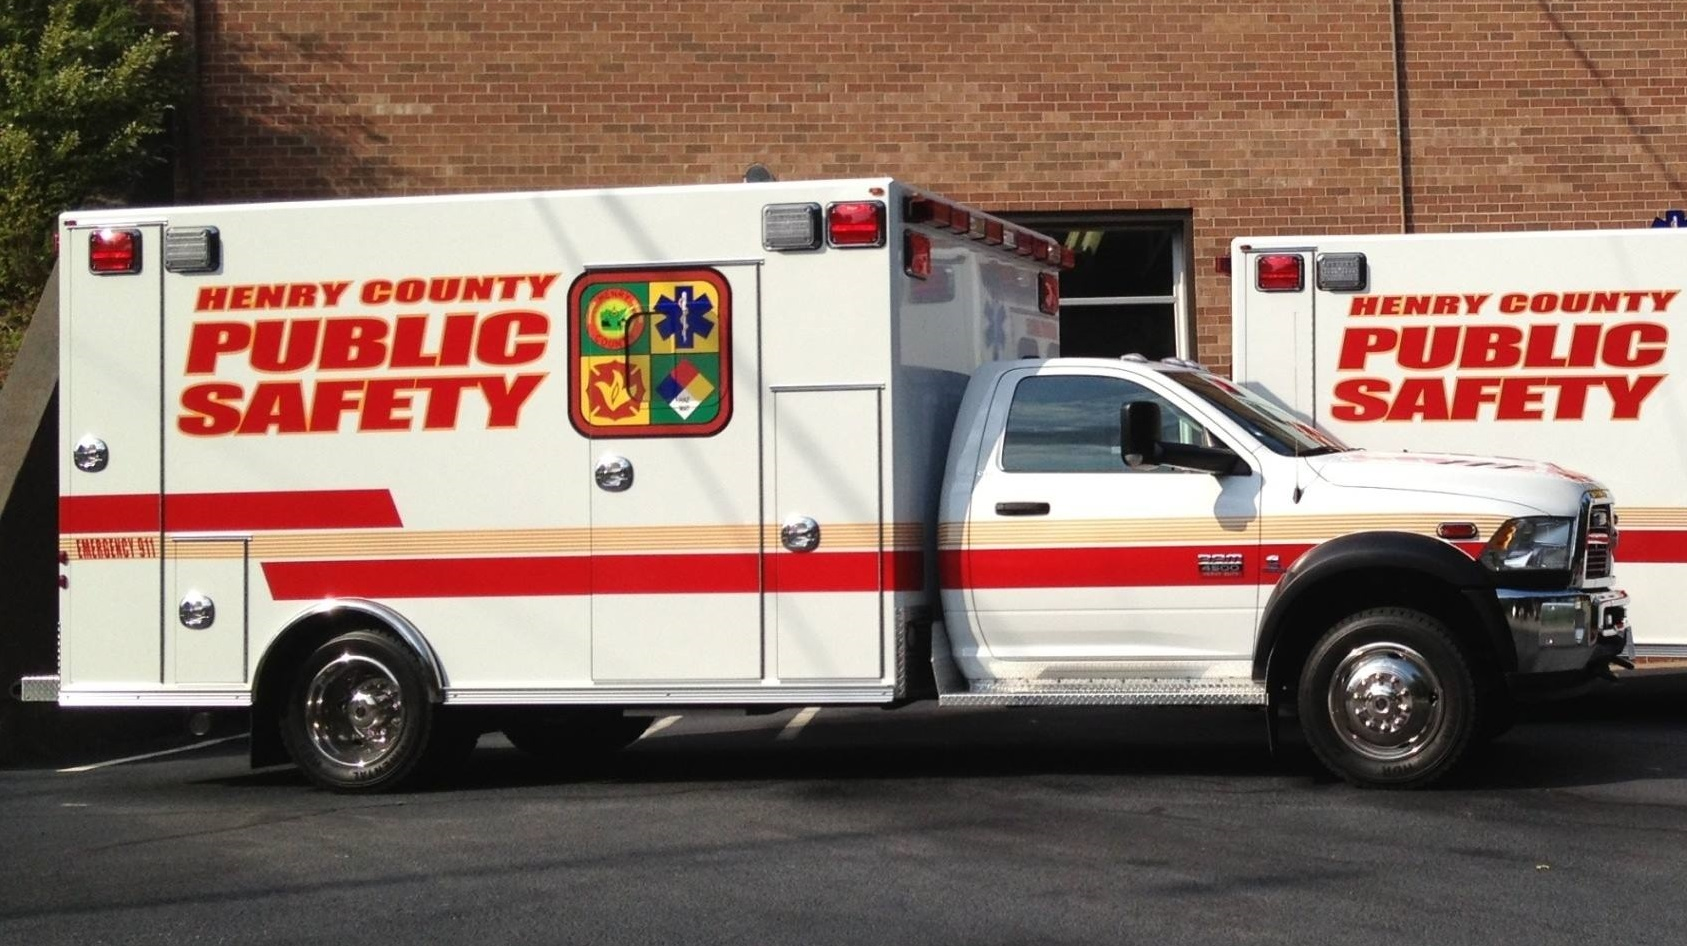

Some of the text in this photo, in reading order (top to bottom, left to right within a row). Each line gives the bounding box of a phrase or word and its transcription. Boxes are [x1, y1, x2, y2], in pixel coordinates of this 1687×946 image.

[195, 279, 354, 313] HENRY
[359, 272, 561, 308] COUNTY
[1348, 289, 1680, 318] HENRY COUNTY
[184, 309, 551, 377] PUBLIC
[1336, 321, 1670, 372] PUBLIC
[177, 371, 549, 438] SAFETY
[1330, 374, 1667, 424] SAFETY
[76, 537, 155, 560] EMERGENCY 911
